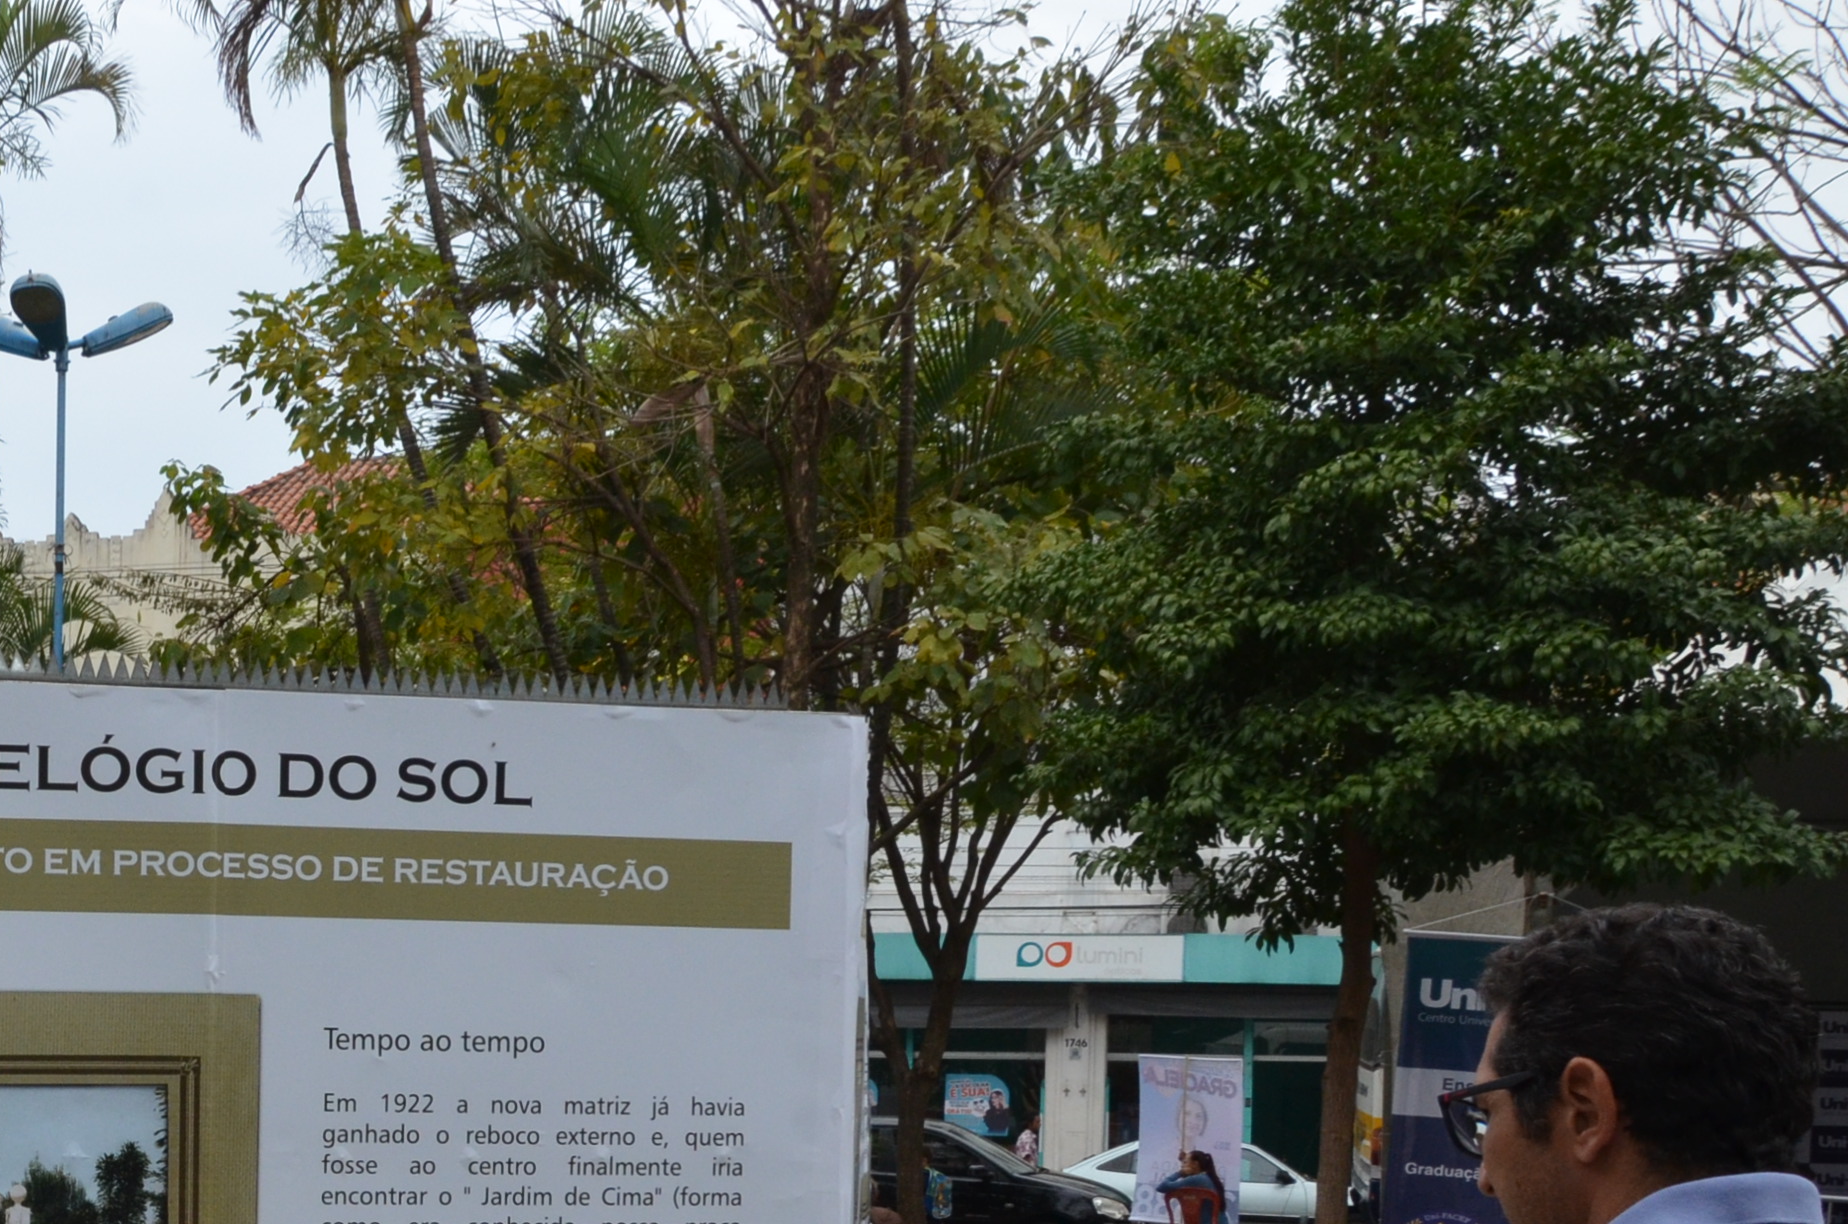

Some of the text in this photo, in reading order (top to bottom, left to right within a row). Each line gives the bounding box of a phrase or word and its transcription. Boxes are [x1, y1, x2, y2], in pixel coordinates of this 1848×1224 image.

[278, 752, 378, 801] DO
[396, 756, 534, 808] SOL
[44, 847, 102, 875] EM
[113, 849, 323, 881] PROCESSO
[333, 855, 385, 883] DE
[394, 857, 670, 897] RESTAURAÇÃO
[1076, 946, 1143, 964] lumini
[1418, 1012, 1456, 1024] Centro
[323, 1026, 546, 1059] Tempo ao tempo
[1064, 1038, 1088, 1049] 1746
[321, 1152, 744, 1177] fosse ao centro finalmente iria
